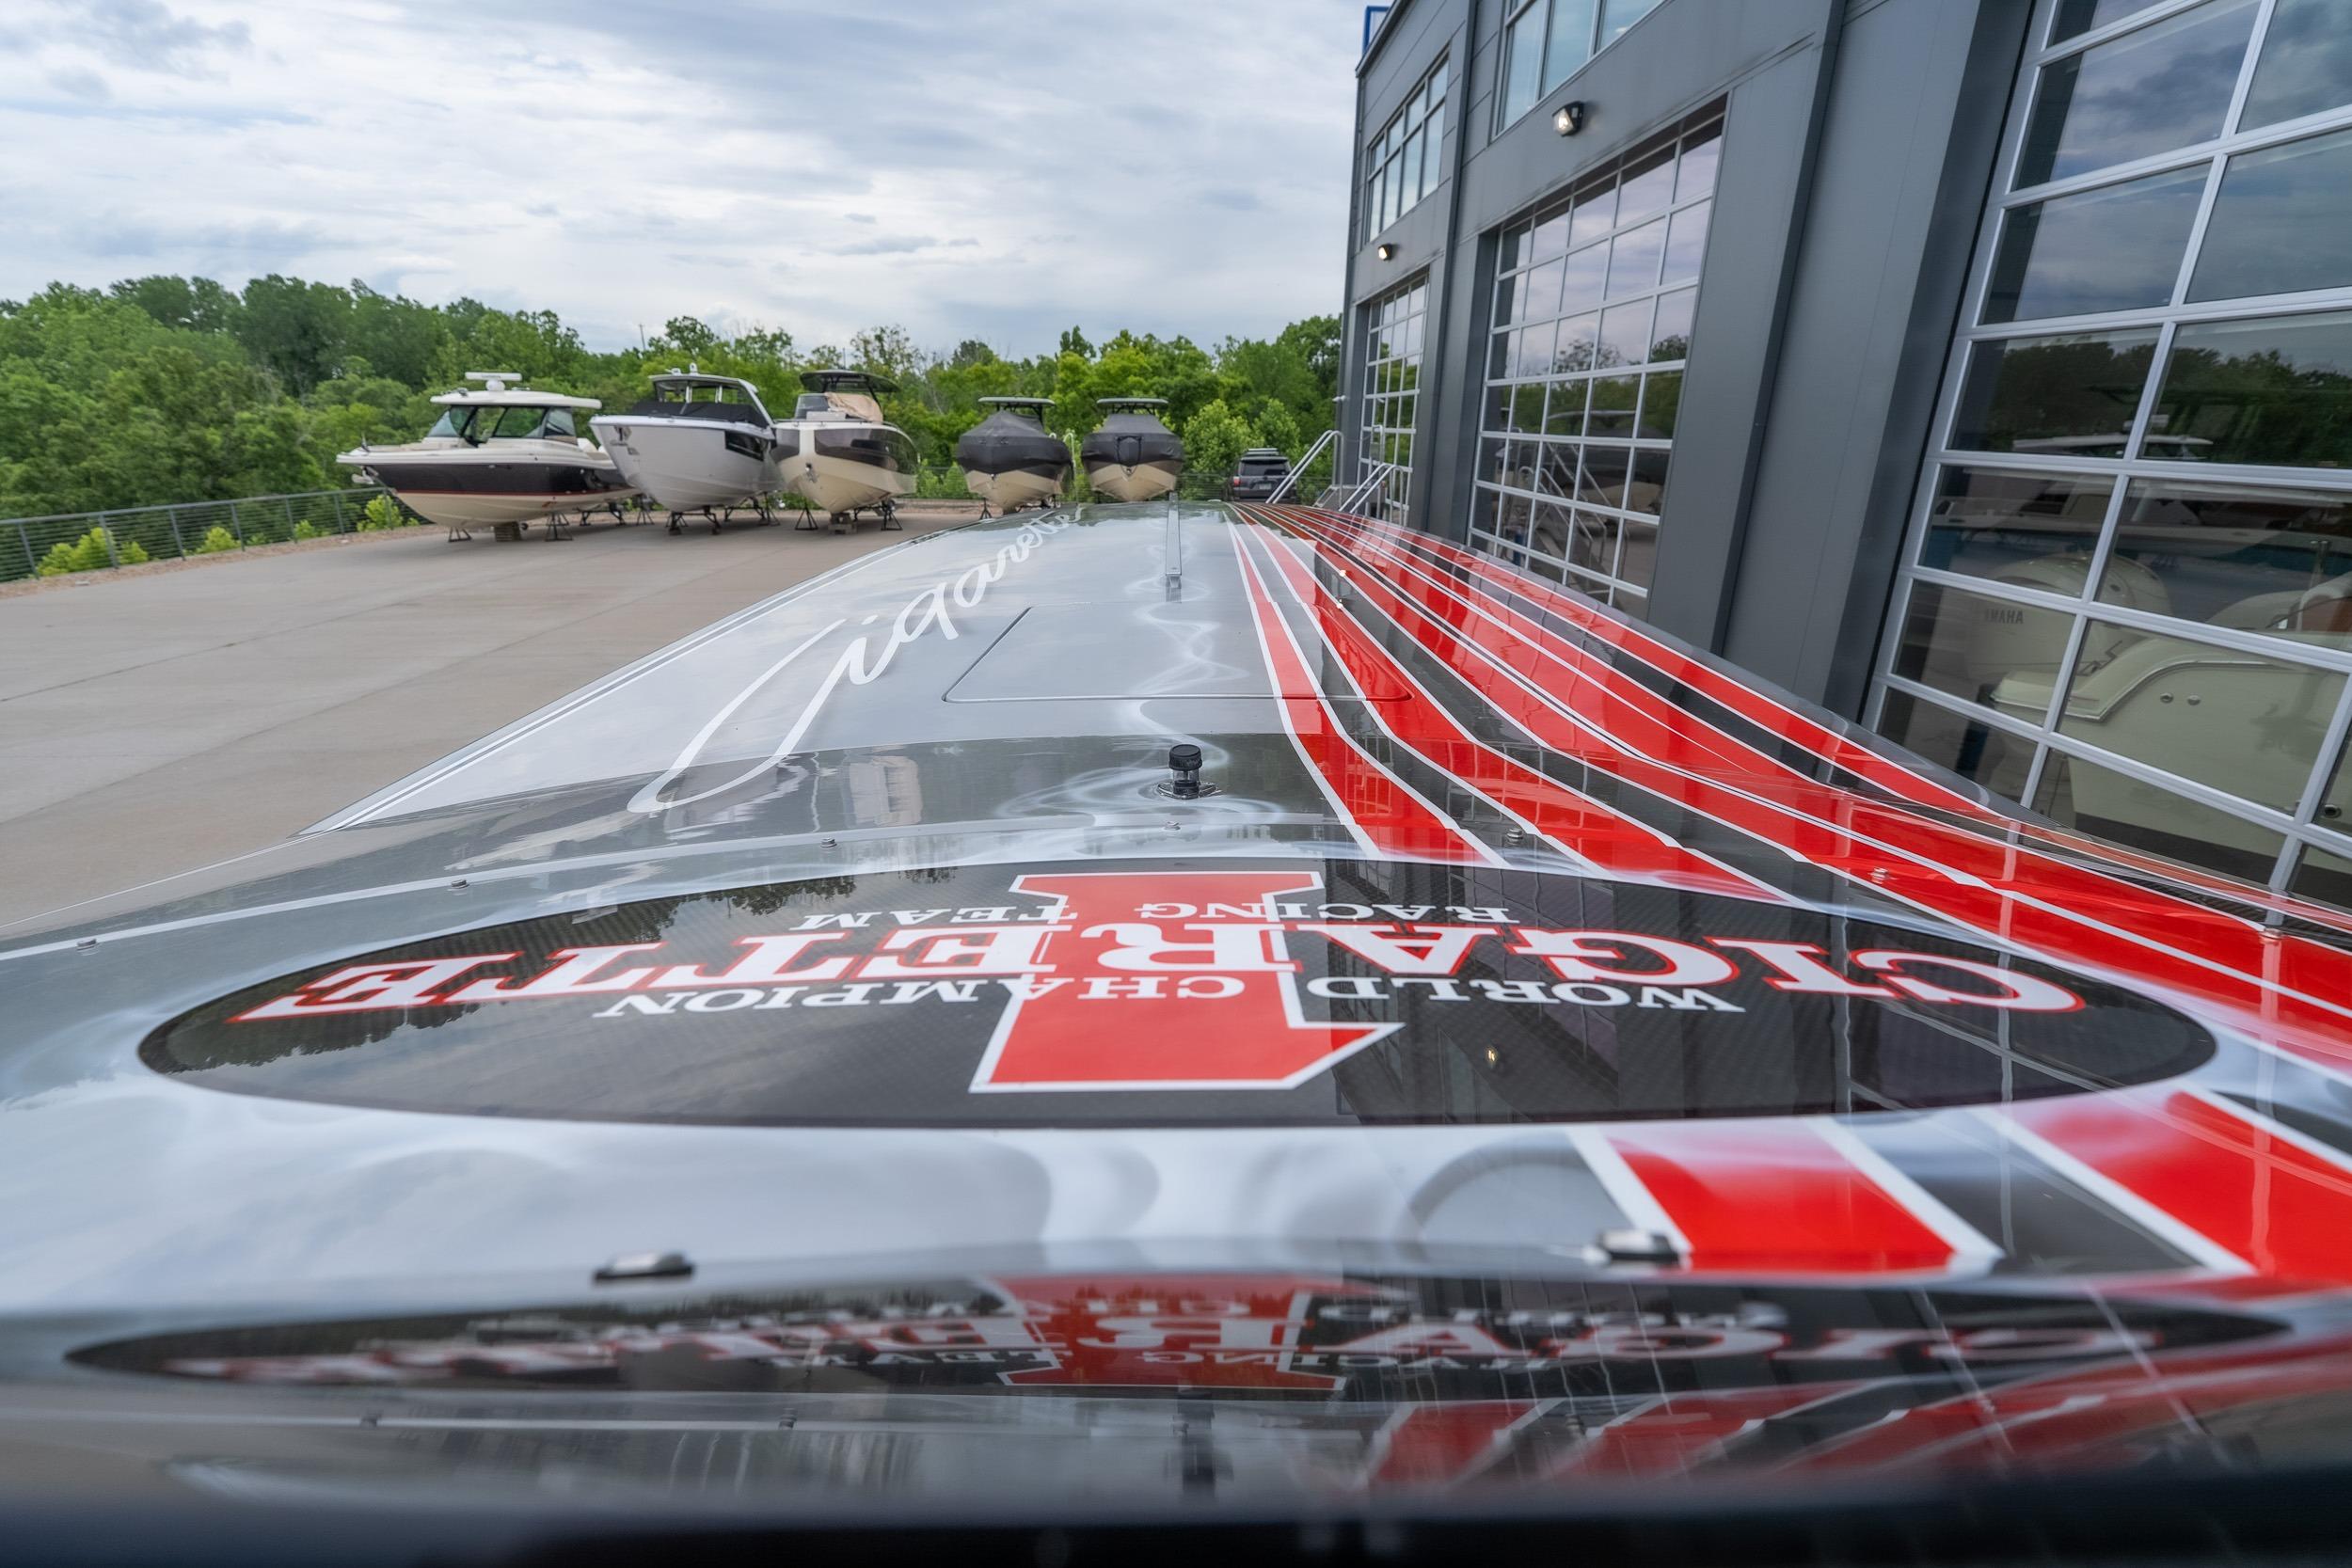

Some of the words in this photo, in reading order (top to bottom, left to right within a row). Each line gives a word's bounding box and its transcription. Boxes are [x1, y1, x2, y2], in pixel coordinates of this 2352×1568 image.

[627, 502, 1085, 814] Cigarette
[788, 904, 1077, 931] TEAM
[1133, 902, 1521, 925] RACING
[222, 922, 2087, 1023] CIGARETTE
[968, 871, 1406, 1093] 1
[1307, 974, 1745, 1013] WORLD
[592, 974, 1247, 1019] CHAMPION
